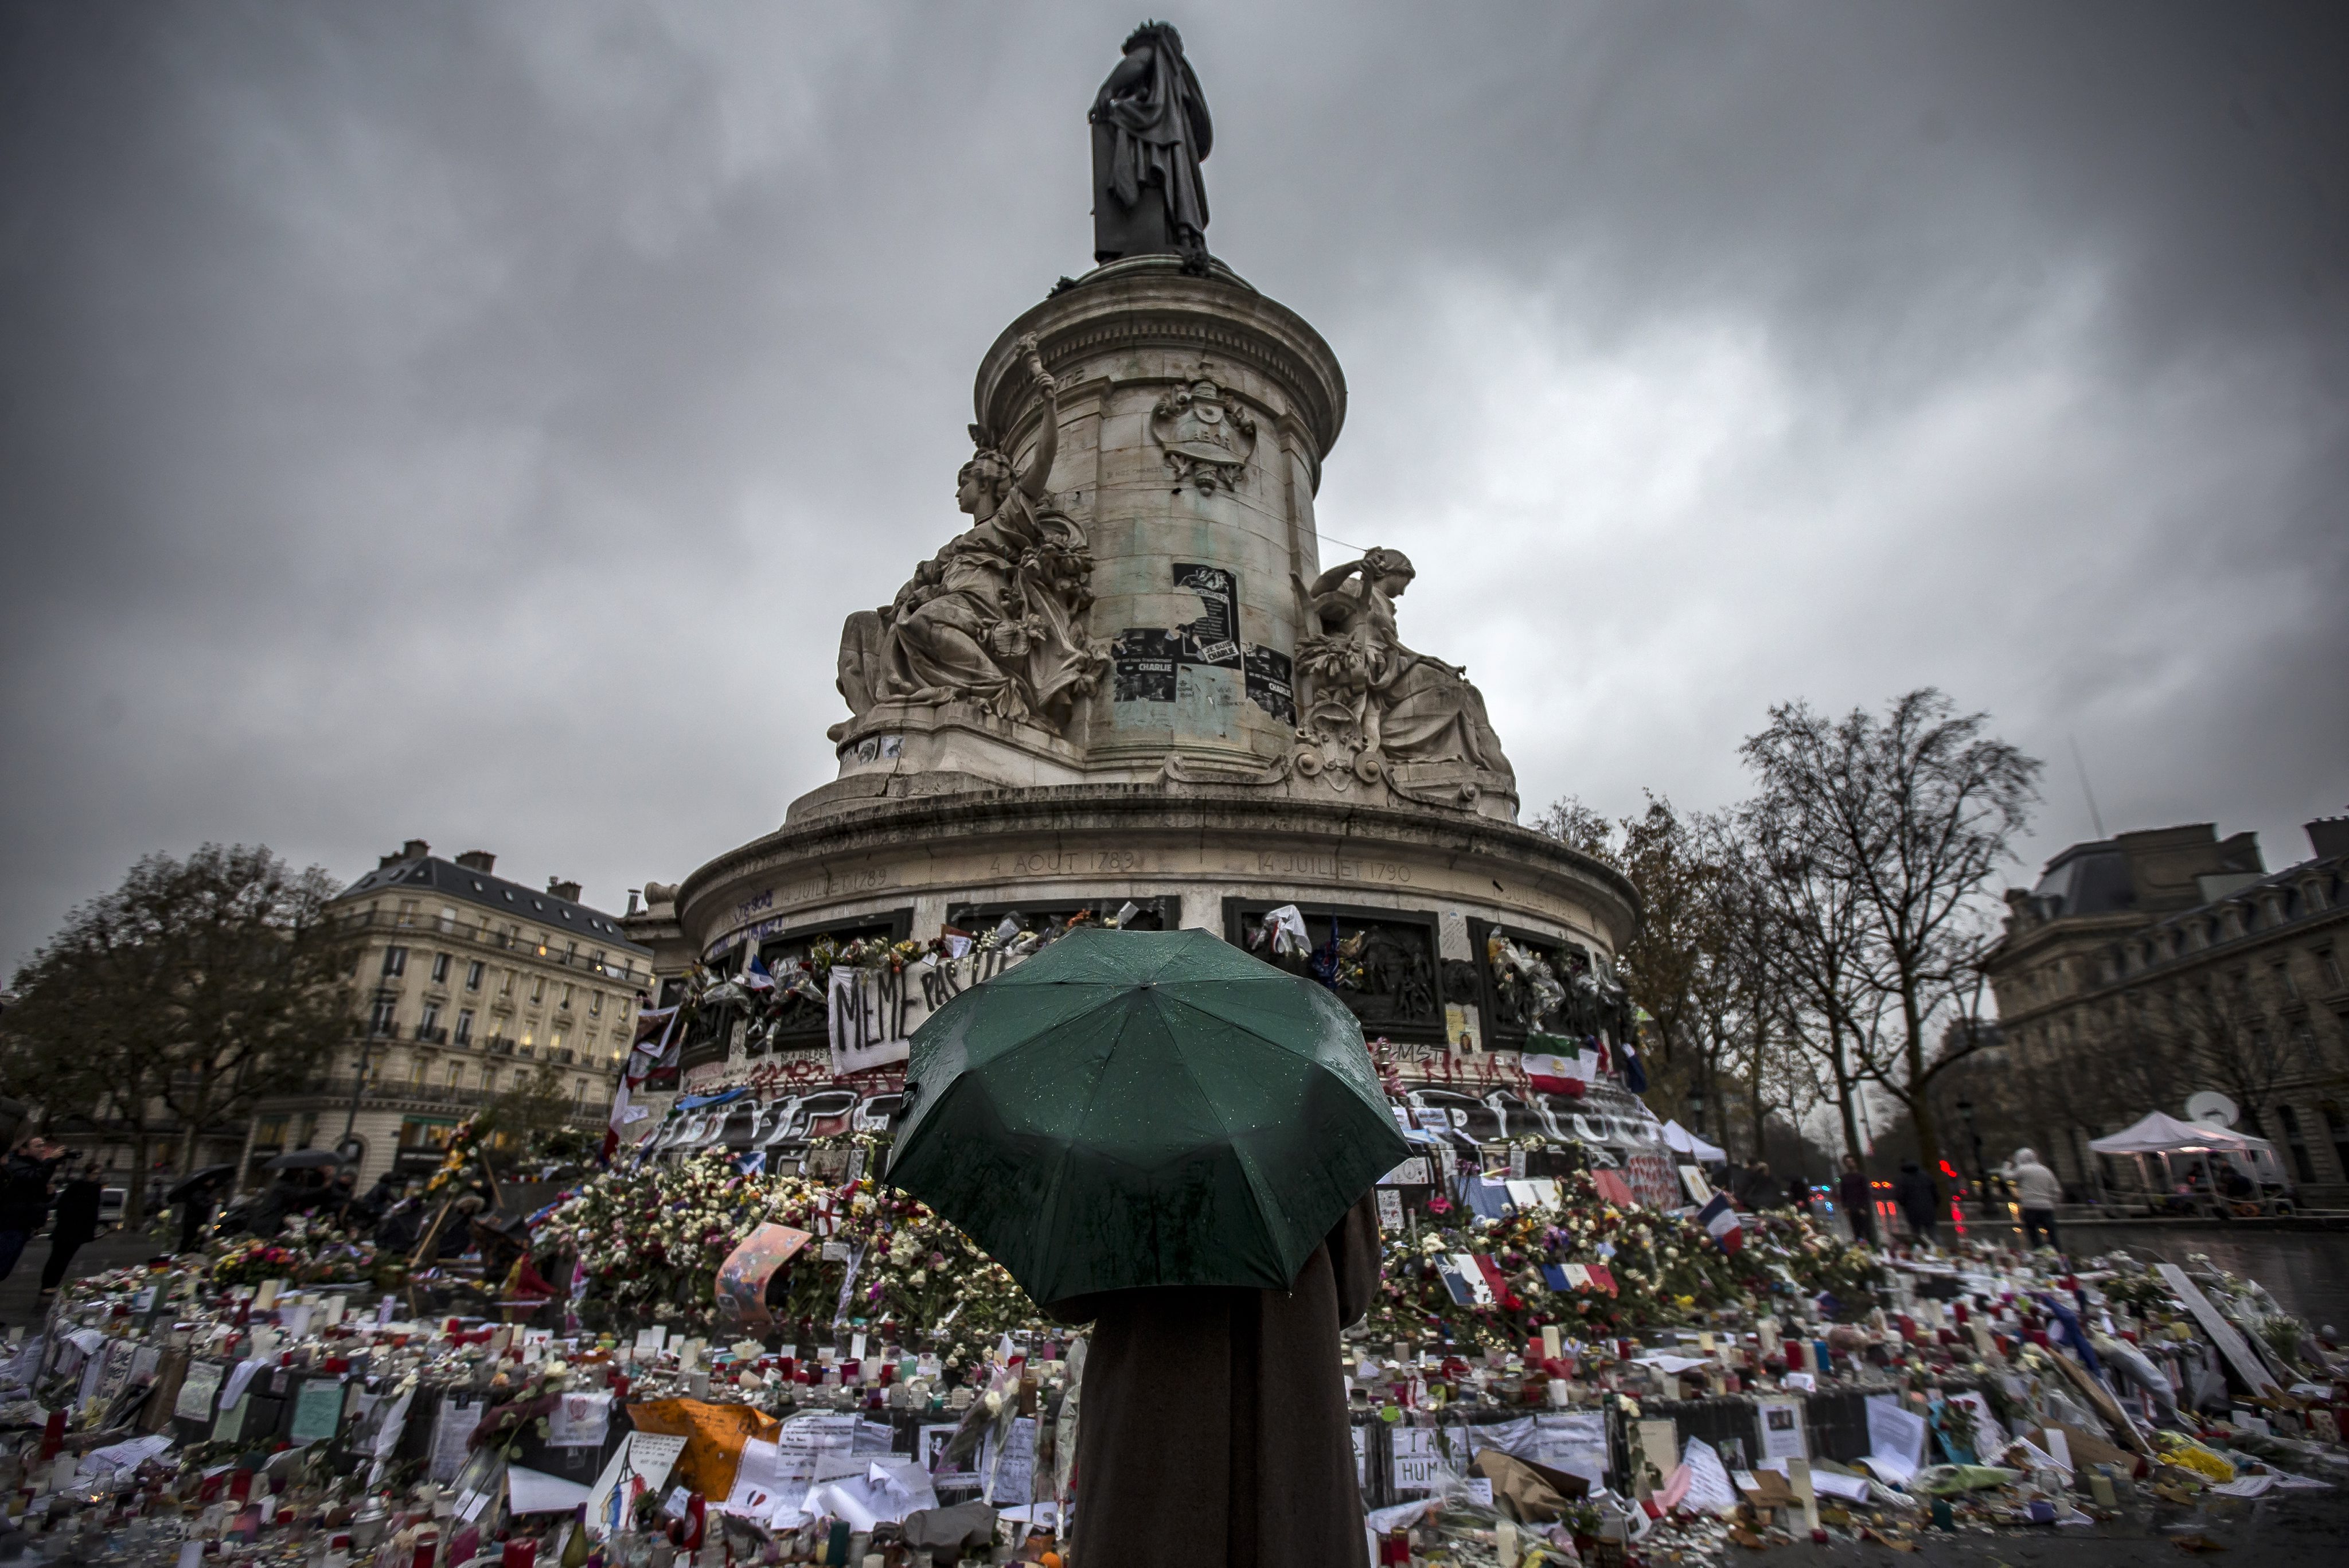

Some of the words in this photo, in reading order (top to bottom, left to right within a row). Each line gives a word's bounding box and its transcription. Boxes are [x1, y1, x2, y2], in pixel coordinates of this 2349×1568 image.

[1205, 646, 1214, 654] JE
[1215, 642, 1232, 650] SUIS
[1208, 646, 1236, 661] CHARLIE
[1138, 662, 1172, 672] CHARLIE
[1269, 682, 1291, 698] CHARLIE
[1013, 852, 1078, 872] AOUT
[1090, 851, 1134, 869] 1789
[1258, 854, 1274, 872] 14
[1284, 856, 1363, 877] JUILLET
[1369, 862, 1411, 882] 1790
[1402, 1460, 1459, 1481] HUMN
